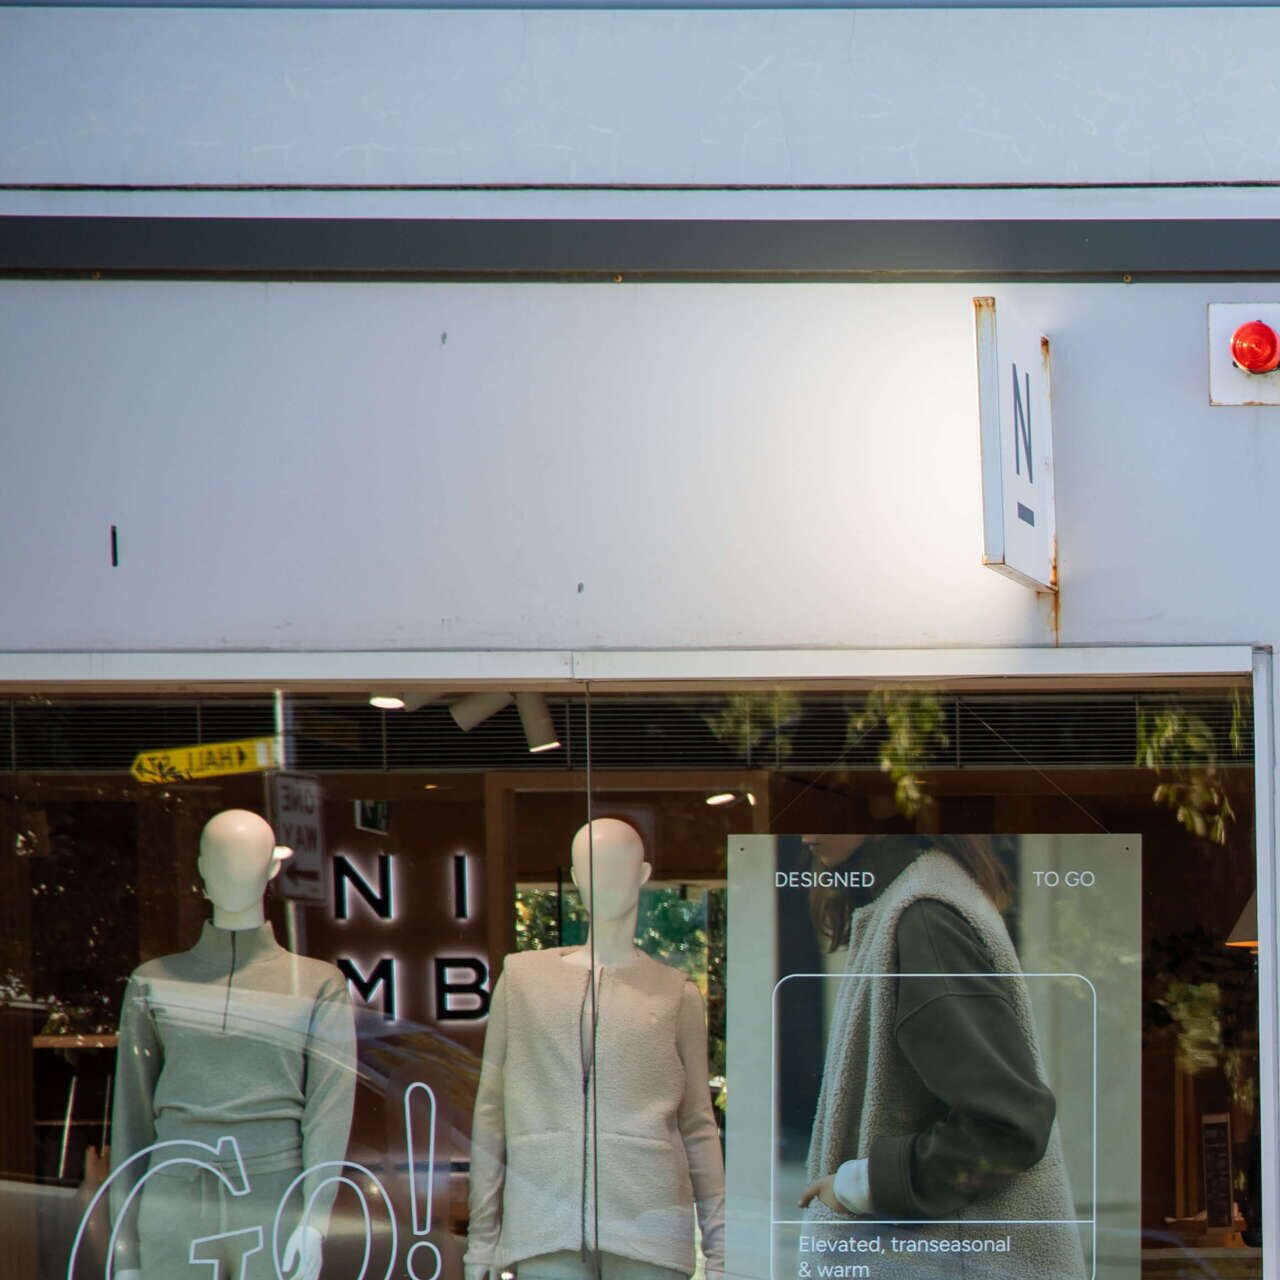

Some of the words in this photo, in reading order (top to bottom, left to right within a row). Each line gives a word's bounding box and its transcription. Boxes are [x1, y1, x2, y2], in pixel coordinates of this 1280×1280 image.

[774, 871, 875, 888] DESIGNED
[1032, 871, 1058, 887] TO
[1064, 871, 1095, 887] GO
[799, 1236, 886, 1255] Elevated,
[892, 1236, 1011, 1252] transeasonal
[798, 1261, 812, 1278] &
[817, 1264, 870, 1278] warm
